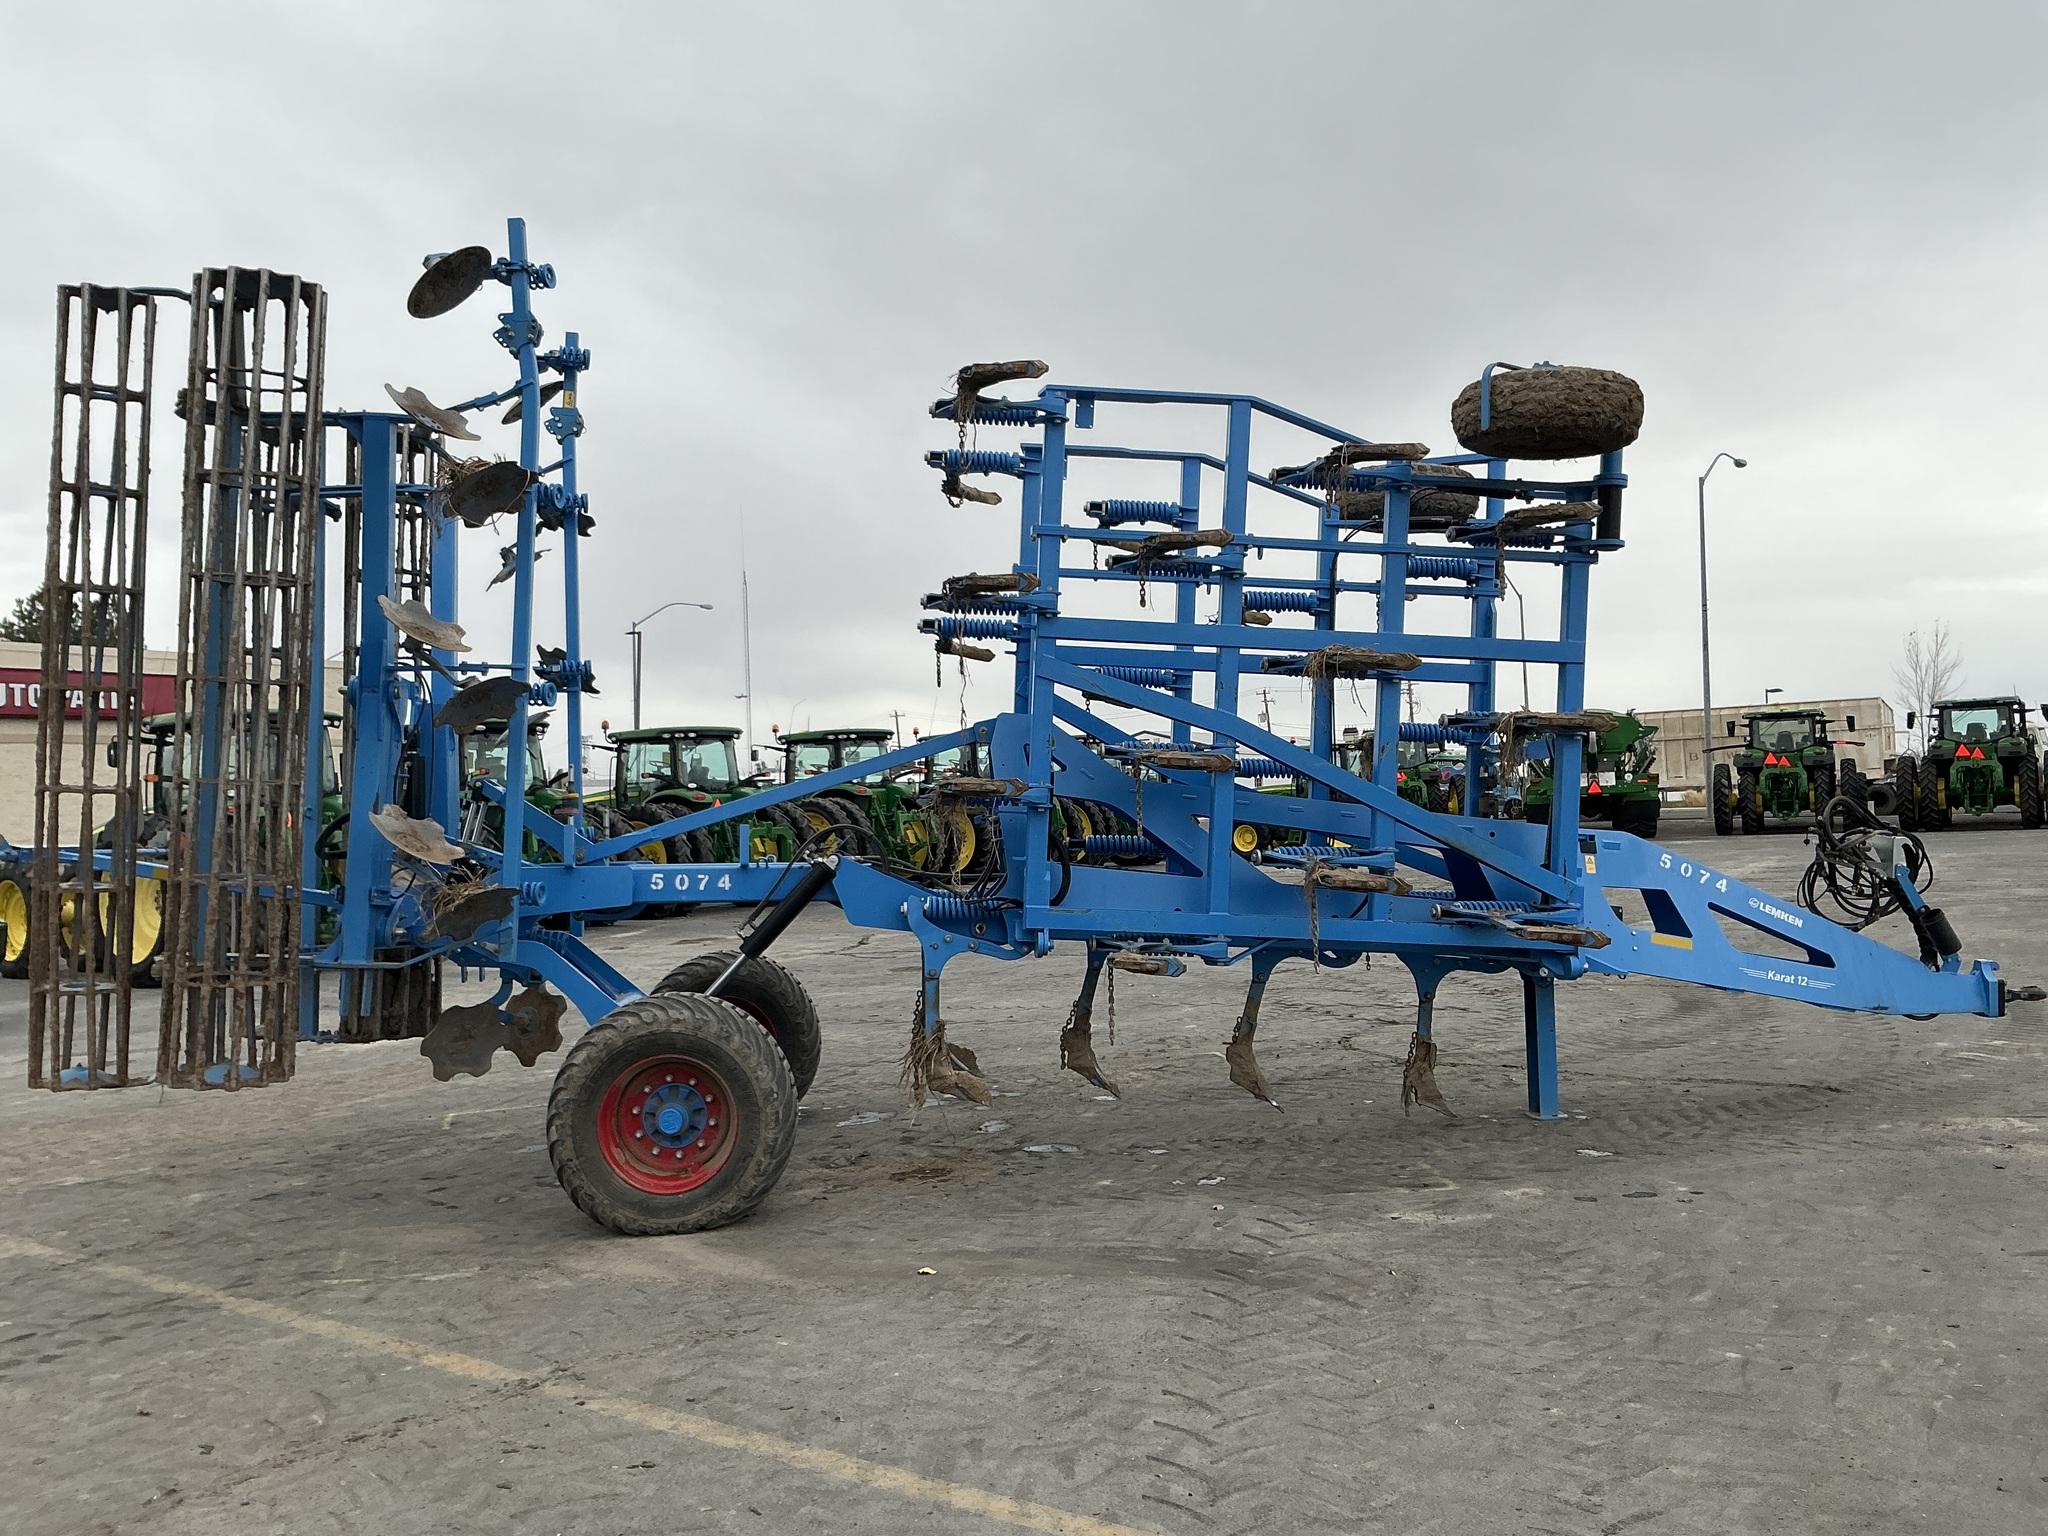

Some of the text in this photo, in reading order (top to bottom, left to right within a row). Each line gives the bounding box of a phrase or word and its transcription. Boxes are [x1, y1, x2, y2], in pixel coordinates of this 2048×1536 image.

[650, 873, 732, 891] 5074
[1660, 853, 1728, 893] 5074
[1759, 901, 1804, 929] LEMKEN
[1767, 970, 1808, 986] Karat 12
